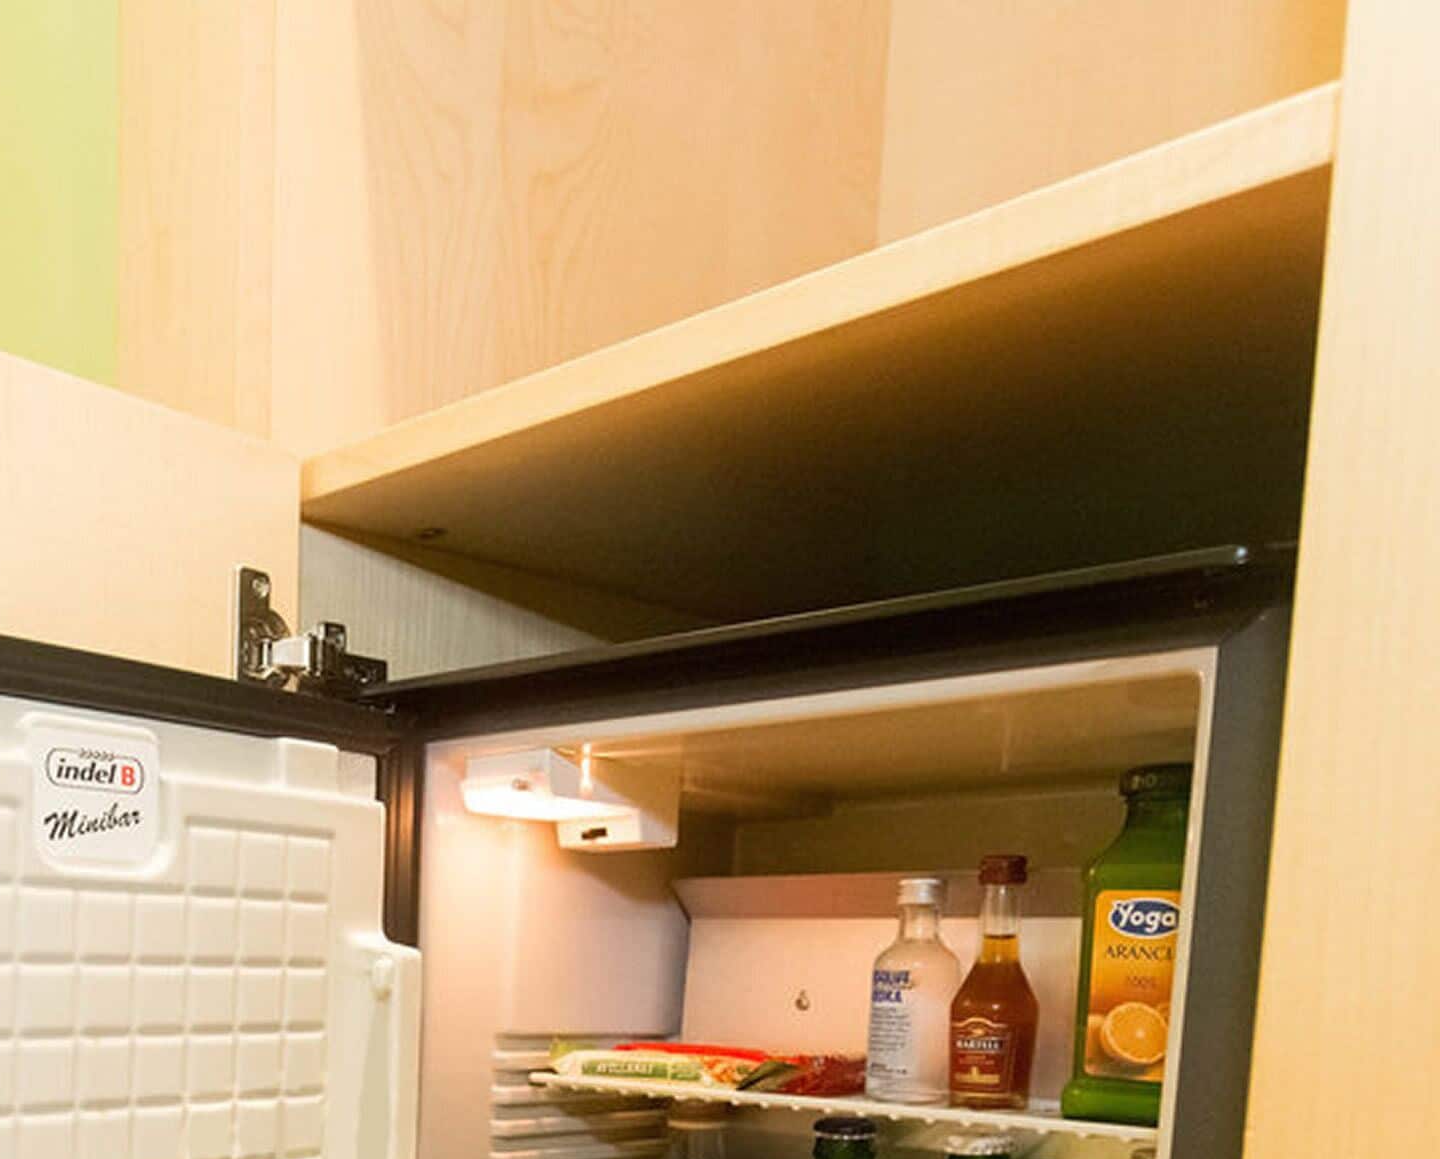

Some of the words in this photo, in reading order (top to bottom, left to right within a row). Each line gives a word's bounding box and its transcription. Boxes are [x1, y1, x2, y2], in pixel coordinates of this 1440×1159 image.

[56, 758, 118, 784] indel
[121, 765, 136, 787] B
[44, 802, 141, 841] Minibar
[1112, 902, 1177, 933] Yoga
